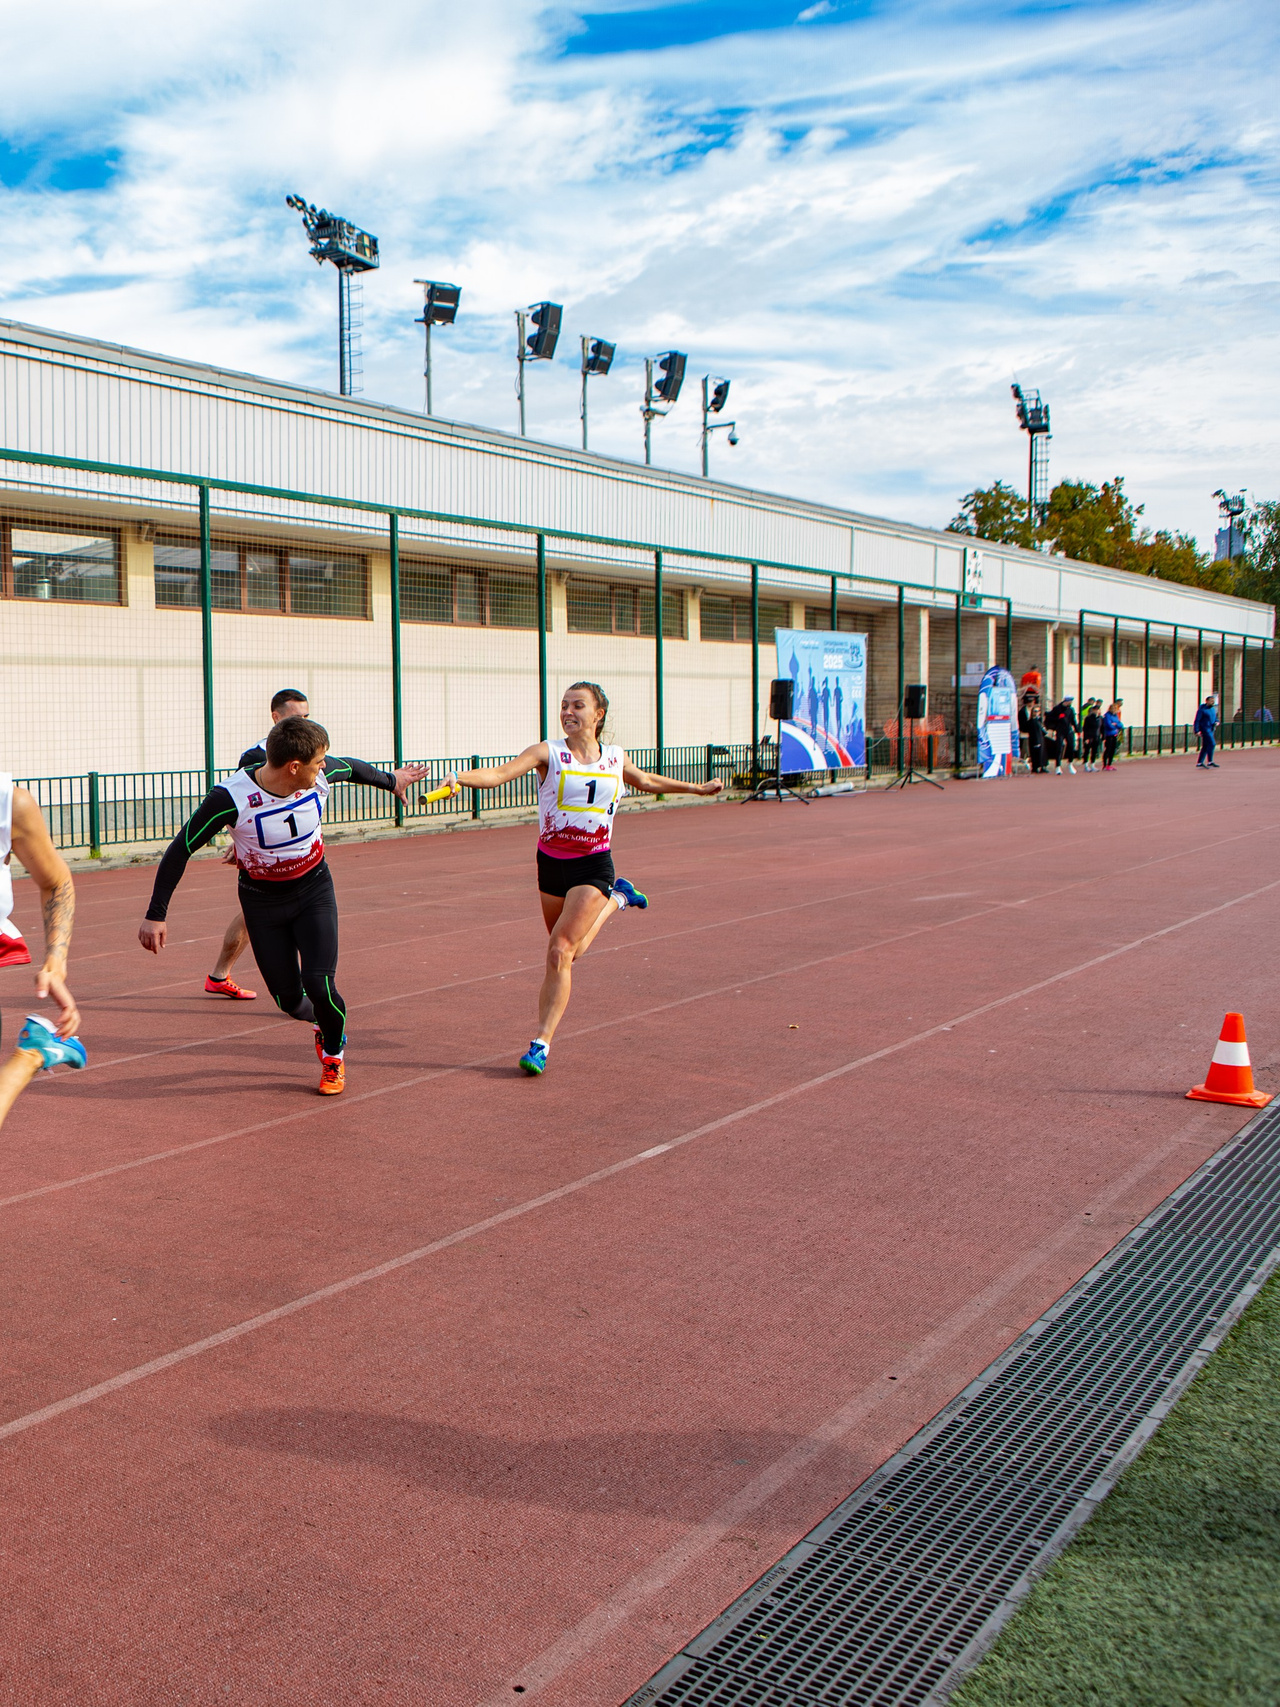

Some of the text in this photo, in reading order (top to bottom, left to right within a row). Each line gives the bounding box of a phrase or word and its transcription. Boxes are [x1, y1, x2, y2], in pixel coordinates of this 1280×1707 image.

[823, 654, 844, 669] 2025
[585, 780, 597, 804] 1
[607, 802, 614, 815] 3
[283, 813, 298, 838] 1
